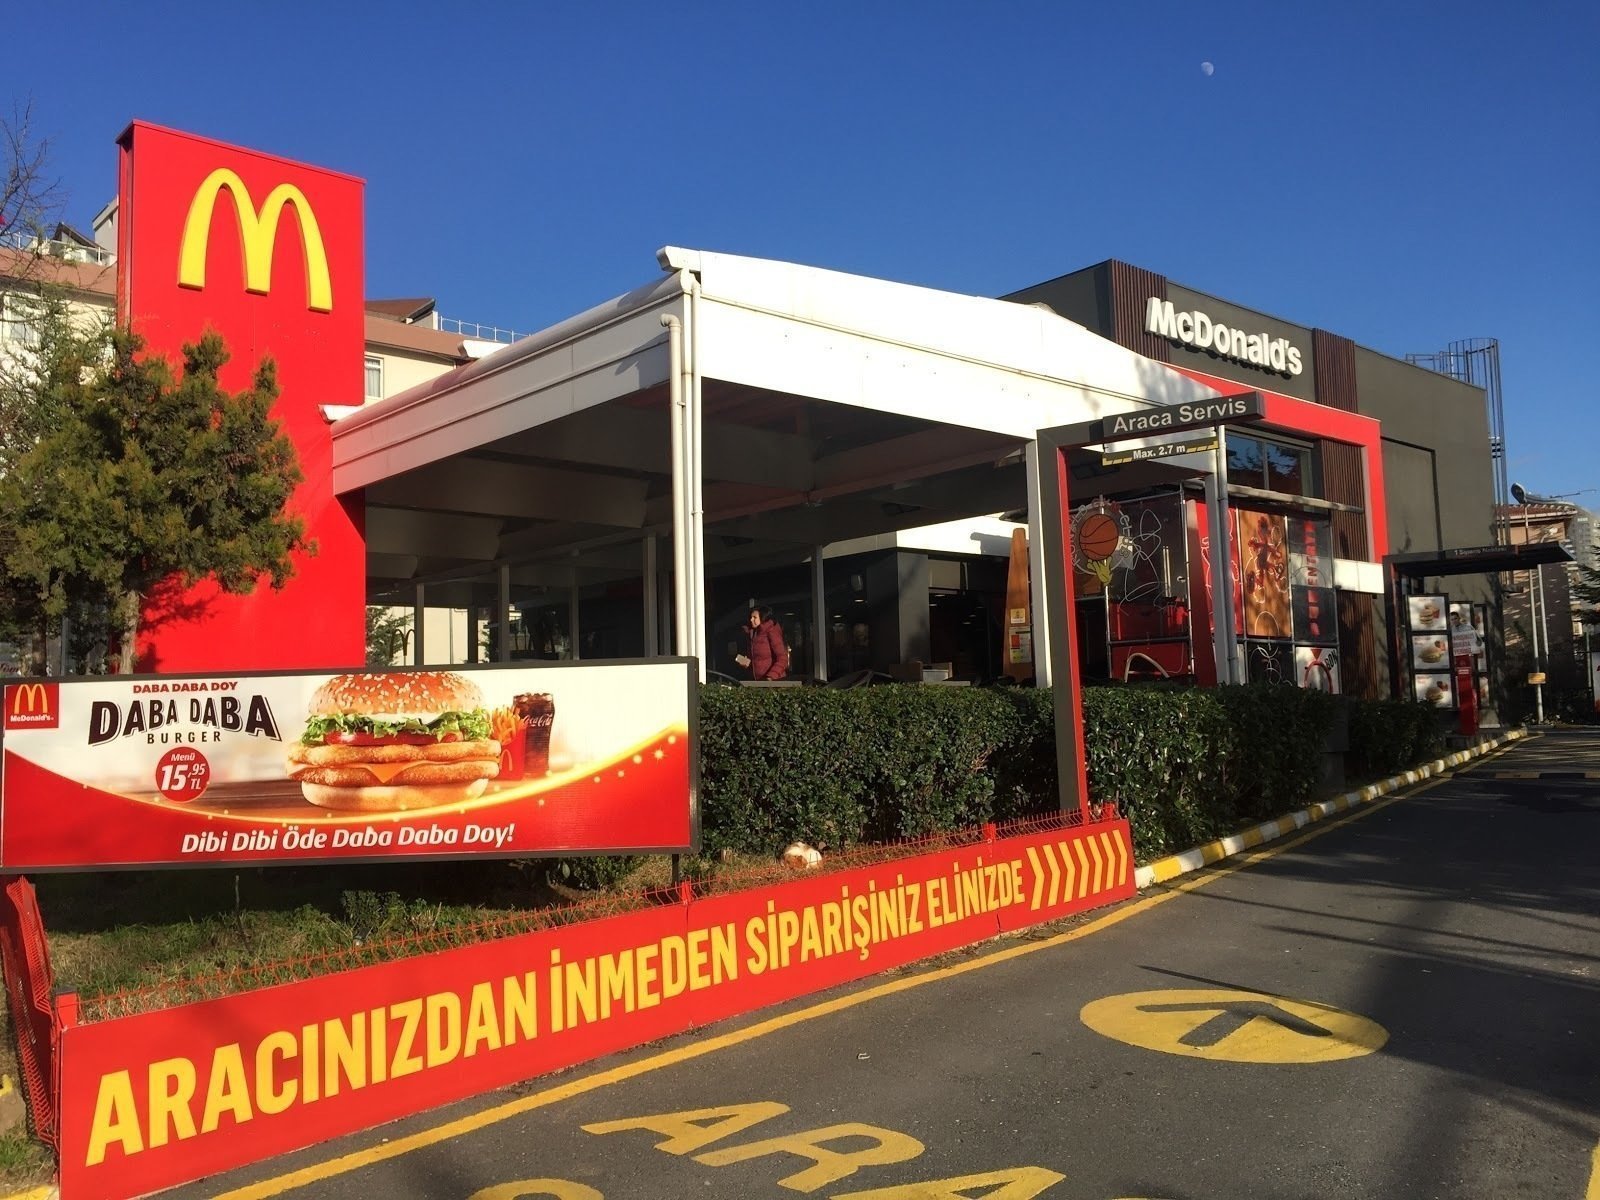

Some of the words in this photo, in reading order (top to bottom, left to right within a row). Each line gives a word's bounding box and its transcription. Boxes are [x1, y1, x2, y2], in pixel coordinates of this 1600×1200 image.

[1146, 297, 1303, 376] McDonald's
[1113, 412, 1172, 433] Araca
[1179, 398, 1247, 423] Servis
[1133, 448, 1156, 460] Max.
[1158, 445, 1173, 456] 2.7
[1176, 444, 1186, 454] m
[133, 684, 170, 694] DABA
[171, 682, 208, 692] DABA
[210, 681, 238, 691] DOY
[10, 714, 51, 722] McDonald's
[88, 699, 180, 747] DABA
[189, 694, 283, 742] DABA
[147, 731, 221, 744] BURGER
[170, 752, 195, 762] Menü
[190, 778, 202, 790] TL
[181, 830, 229, 853] Dibi
[231, 828, 279, 852] Dibi
[282, 825, 328, 850] Öde
[331, 826, 392, 849] Daba
[397, 824, 458, 847] Daba
[463, 823, 515, 848] Doy!
[85, 970, 538, 1167] ARACINIZDAN
[550, 922, 739, 1034] İNMEDEN
[745, 874, 924, 976] SİPARİŞİNİZ
[928, 856, 1026, 928] ELİNİZDE
